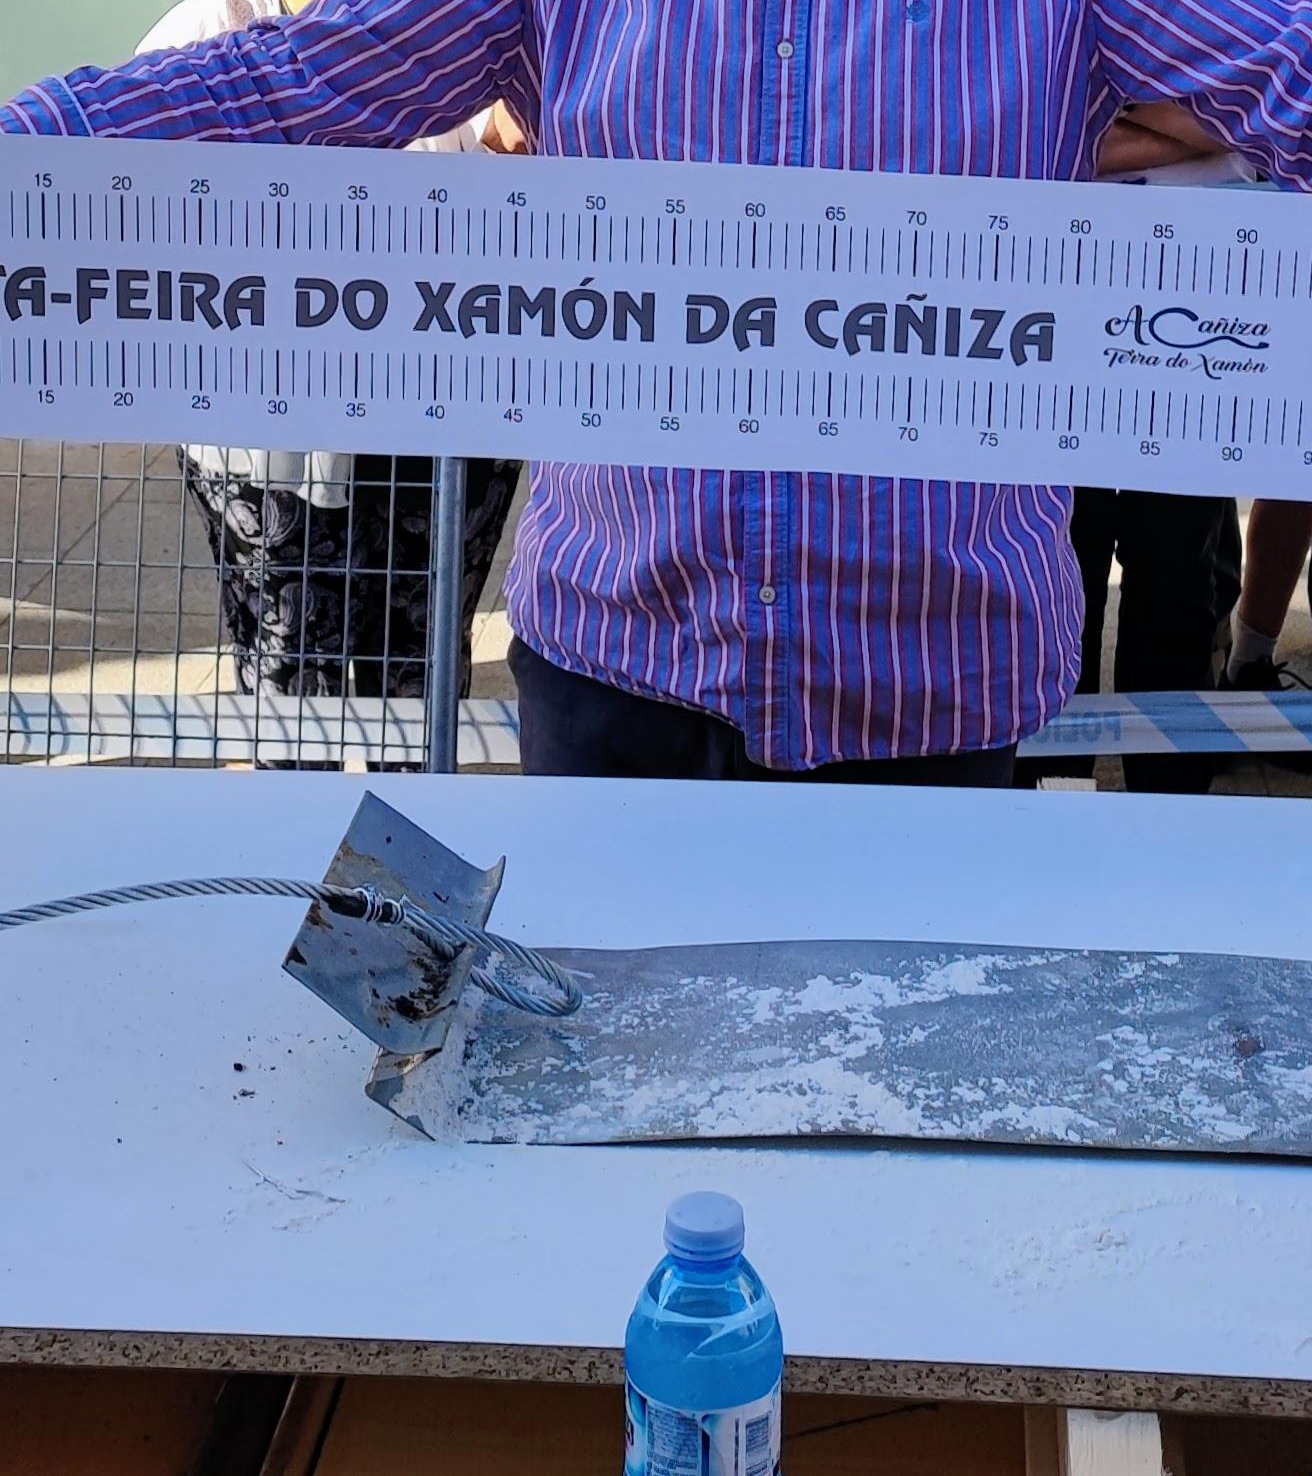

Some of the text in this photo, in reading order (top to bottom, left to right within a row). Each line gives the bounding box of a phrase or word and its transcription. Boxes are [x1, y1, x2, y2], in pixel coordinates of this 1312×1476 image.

[34, 172, 53, 189] 15
[111, 175, 132, 192] 20
[189, 178, 211, 195] 25
[268, 182, 290, 198] 30
[347, 184, 369, 201] 35
[426, 188, 448, 204] 40
[506, 190, 527, 208] 45
[585, 195, 607, 211] 50
[665, 198, 686, 215] 55
[744, 202, 766, 218] 60
[824, 205, 847, 222] 65
[906, 210, 928, 227] 70
[988, 214, 1009, 231] 75
[1069, 218, 1092, 235] 80
[1152, 223, 1175, 240] 85
[1236, 228, 1259, 245] 90
[293, 277, 389, 332] DO
[412, 276, 656, 343] XAMÓN
[684, 293, 778, 353] DA
[804, 292, 1057, 367] CAÑIZA
[1104, 304, 1272, 350] A Cañiza
[1165, 352, 1189, 369] do
[37, 389, 55, 405] 15
[113, 391, 134, 407] 20
[191, 394, 211, 411] 25
[267, 399, 288, 415] 30
[345, 402, 366, 418] 35
[424, 404, 446, 420] 40
[503, 407, 523, 424] 45
[580, 412, 602, 429] 50
[659, 415, 680, 432] 55
[738, 418, 760, 434] 60
[818, 421, 839, 437] 65
[898, 426, 919, 442] 70
[979, 431, 999, 447] 75
[1058, 434, 1080, 451] 80
[1139, 440, 1161, 456] 85
[1221, 446, 1243, 462] 90
